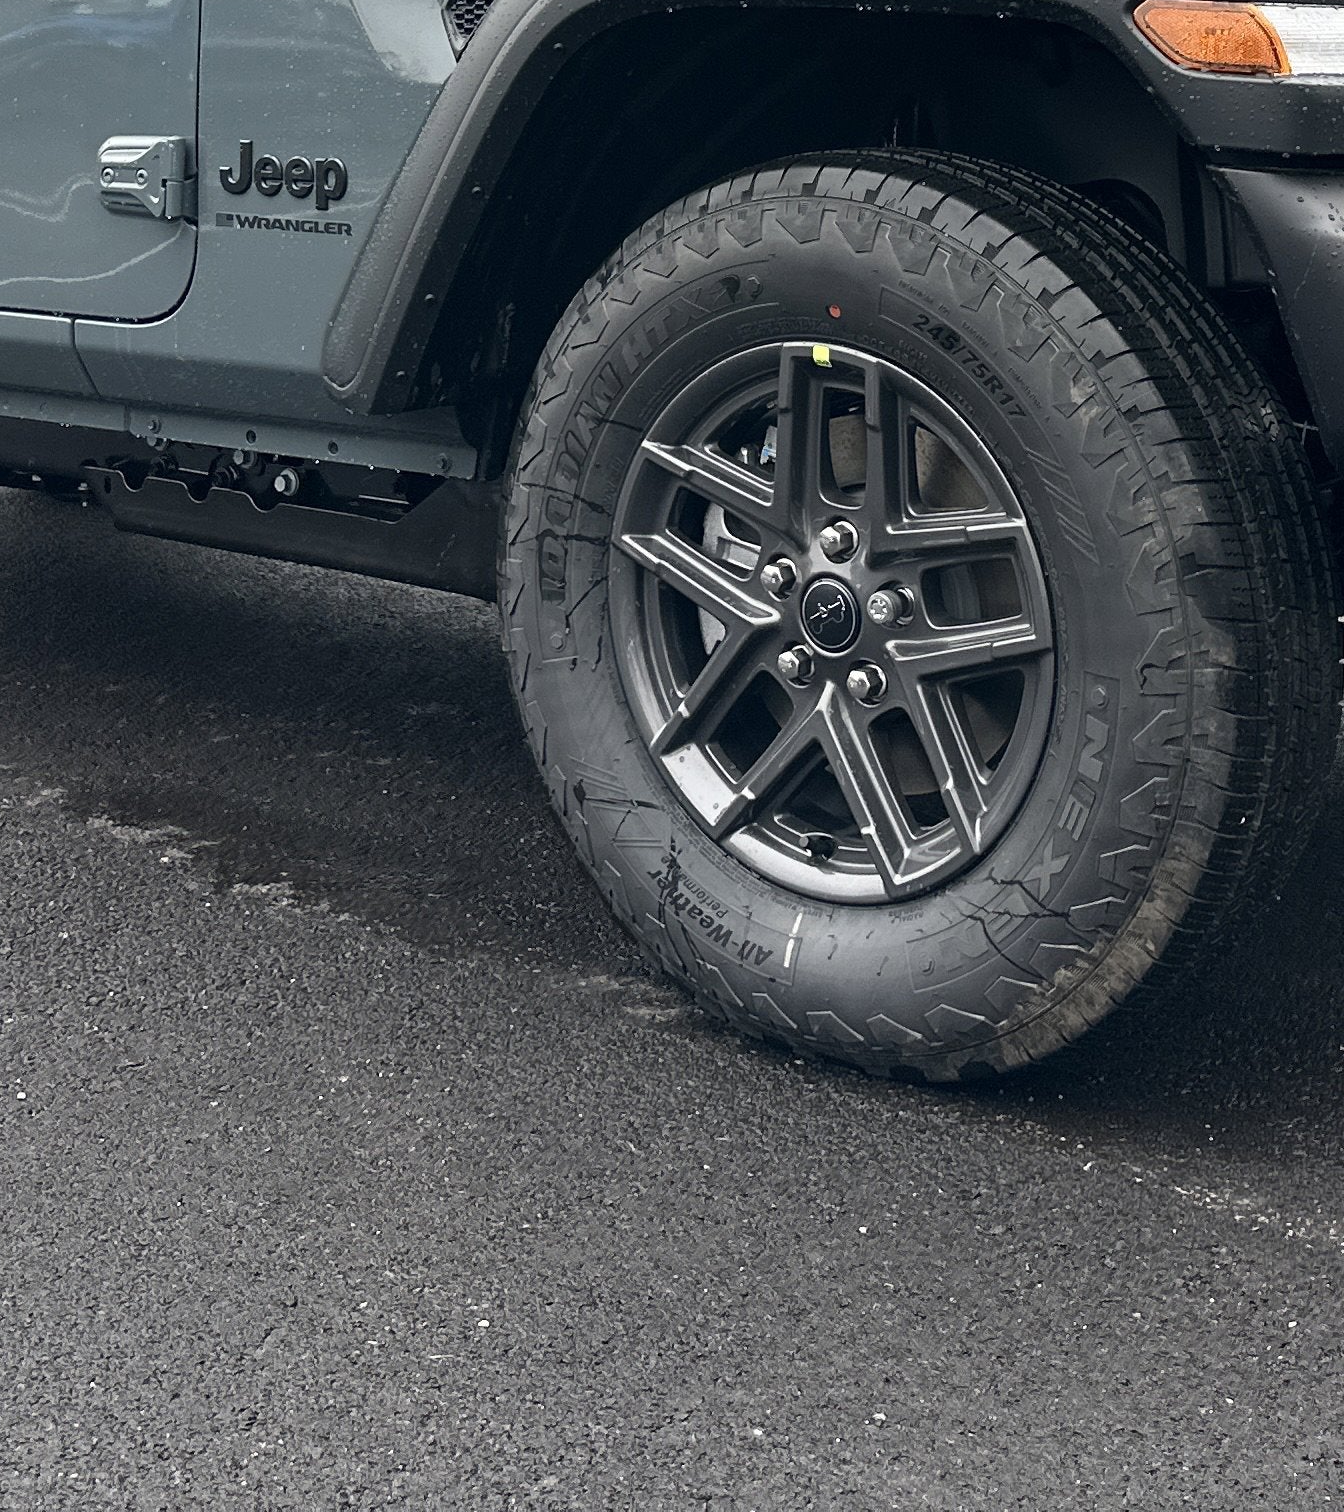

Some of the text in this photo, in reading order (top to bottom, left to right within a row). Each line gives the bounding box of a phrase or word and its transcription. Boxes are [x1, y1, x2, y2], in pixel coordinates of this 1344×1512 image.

[219, 139, 349, 211] Jeep
[234, 213, 353, 237] WRANGLER
[911, 313, 1028, 418] 245/75R17
[660, 854, 729, 920] Performae
